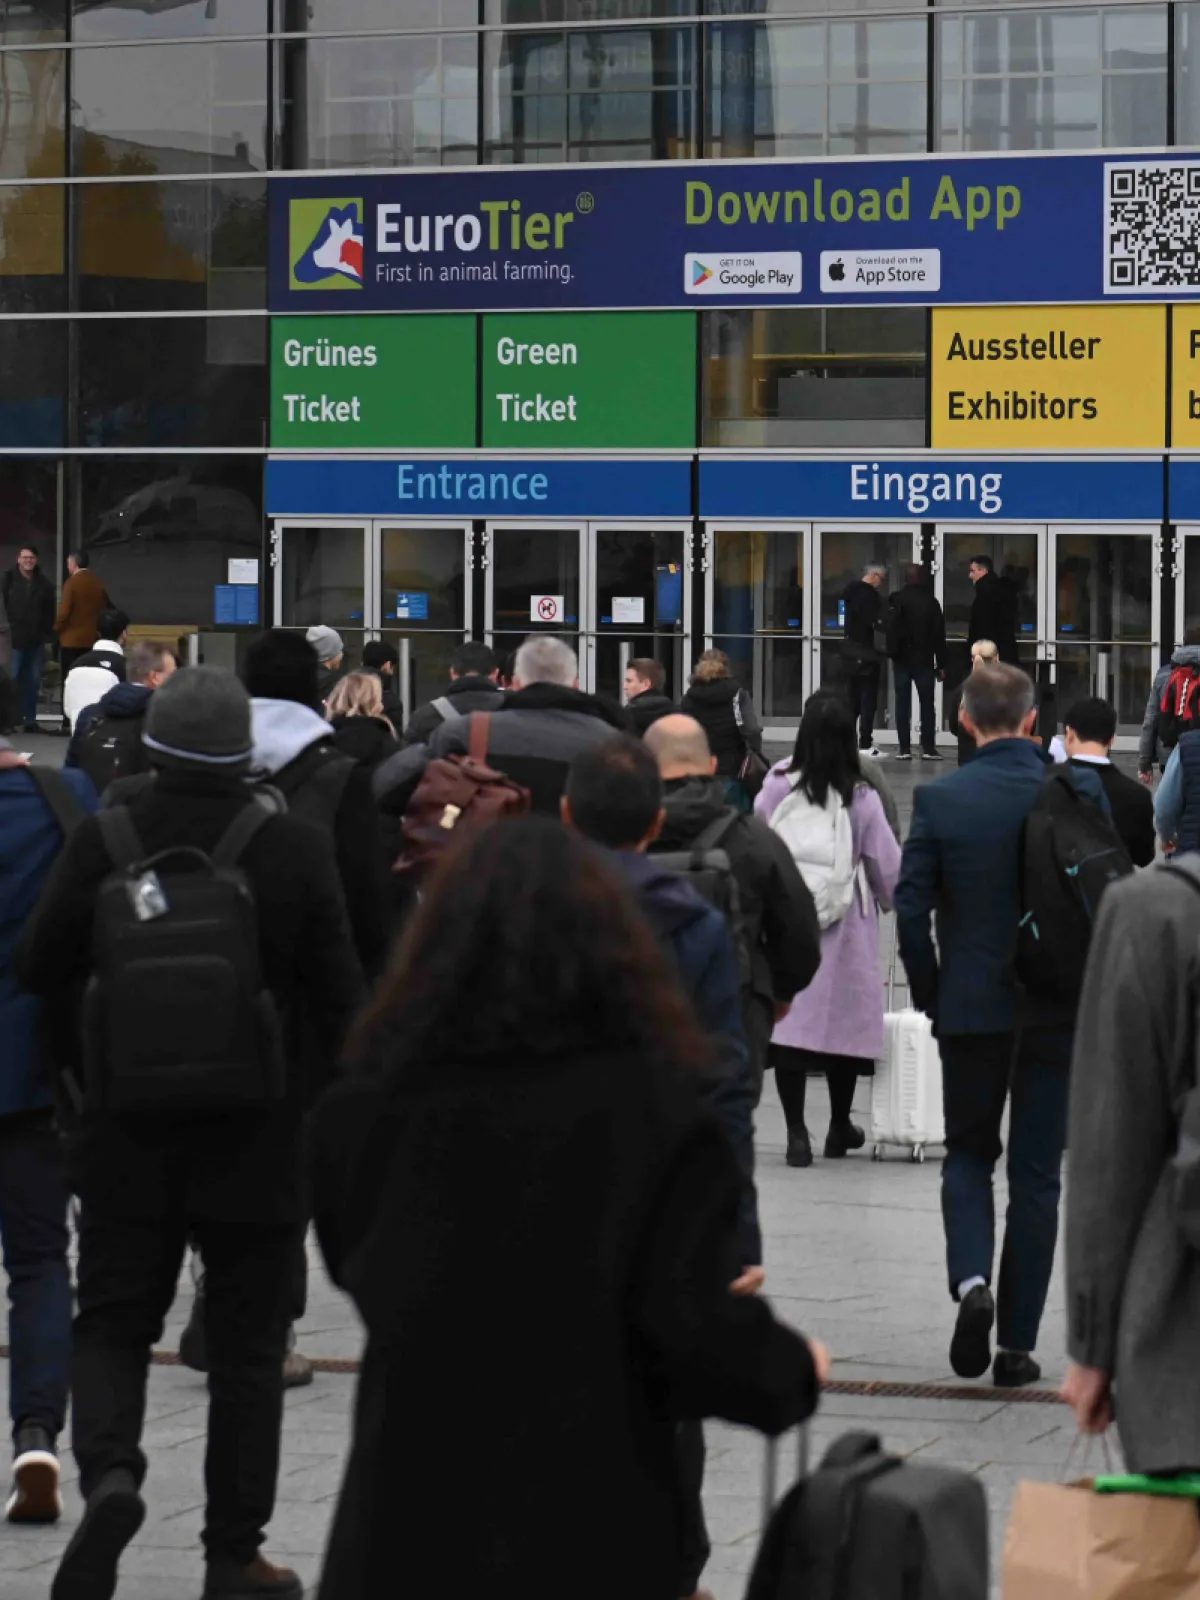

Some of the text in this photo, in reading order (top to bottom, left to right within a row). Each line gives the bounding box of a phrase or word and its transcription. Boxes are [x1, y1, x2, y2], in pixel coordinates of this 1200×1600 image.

[686, 176, 1021, 230] Download App
[377, 201, 572, 252] EuroTier
[376, 261, 574, 284] First in animal farming.
[720, 258, 734, 268] GET
[744, 258, 755, 267] ON
[856, 256, 923, 265] Download on the
[720, 270, 793, 288] Google Play
[856, 267, 925, 285] App Store
[285, 339, 376, 366] Grünes
[498, 337, 576, 364] Green
[947, 331, 1101, 360] Aussteller
[283, 395, 360, 421] Ticket
[496, 394, 576, 421] Ticket
[949, 391, 1097, 420] Exhibitors
[399, 465, 547, 499] Entrance
[851, 465, 1003, 513] Eingang
